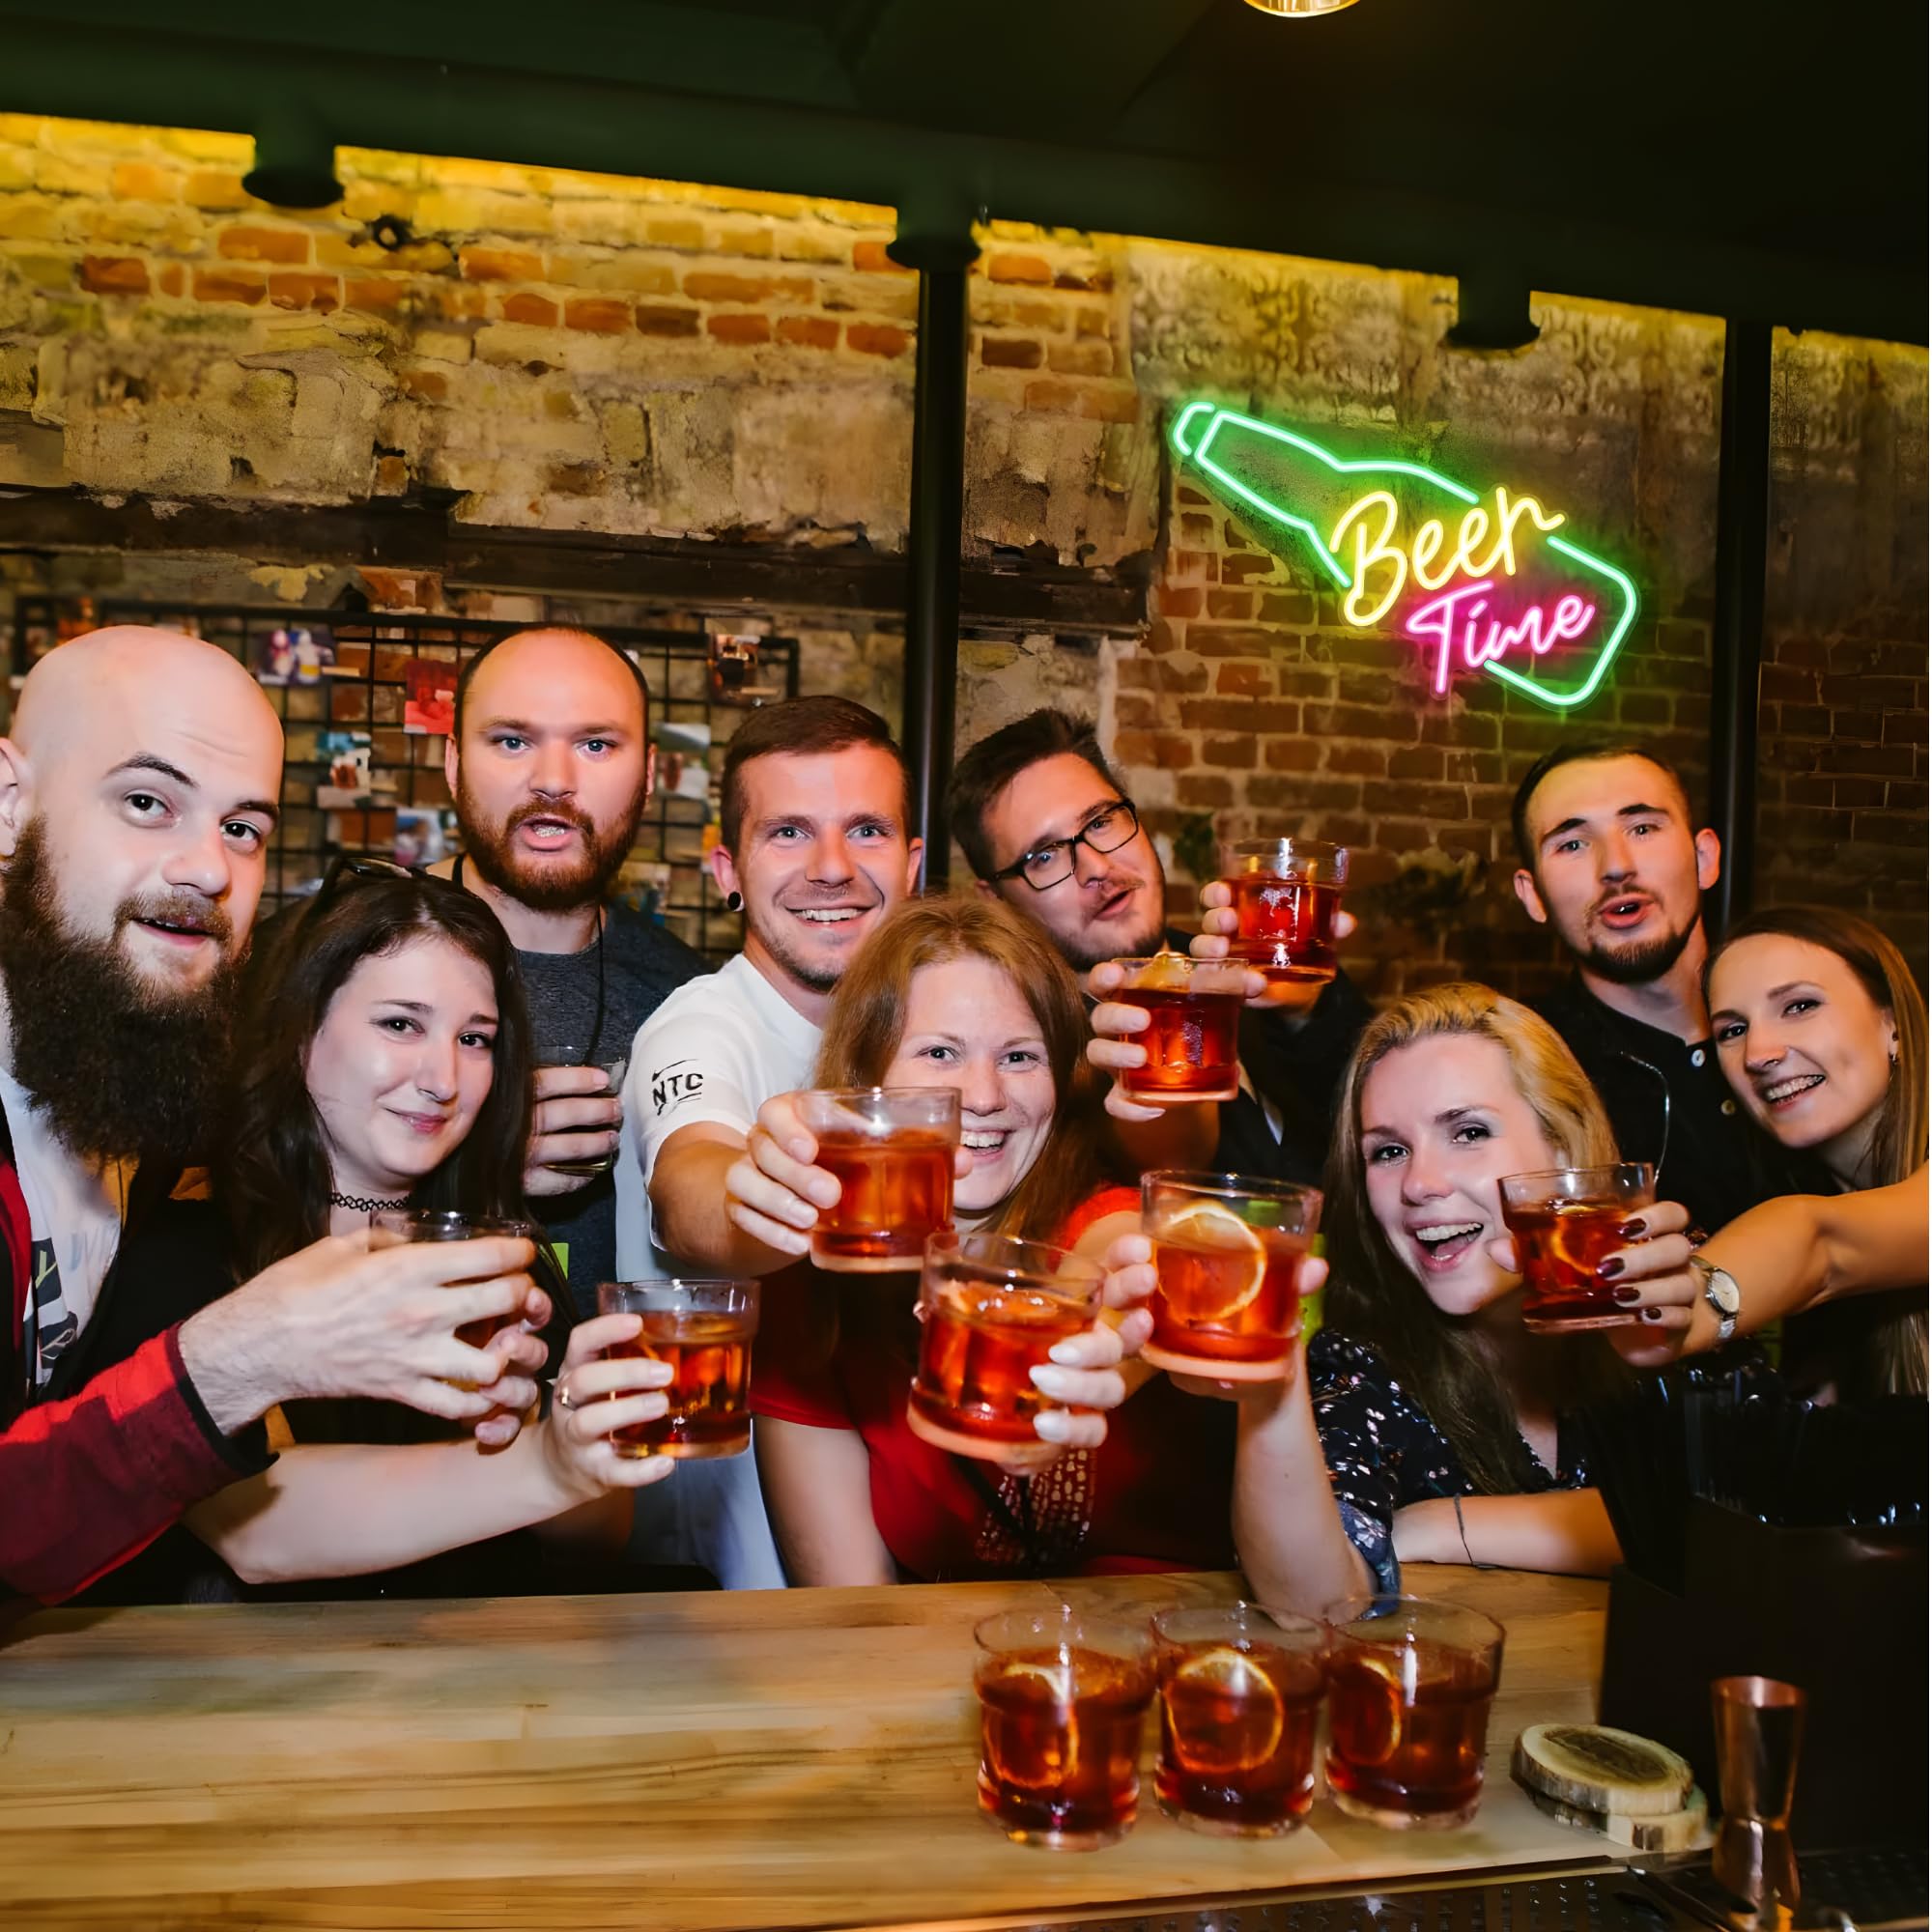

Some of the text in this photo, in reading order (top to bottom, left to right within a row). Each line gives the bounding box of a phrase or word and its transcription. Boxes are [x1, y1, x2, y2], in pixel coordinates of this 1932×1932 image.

[1329, 487, 1566, 627] Beer
[1405, 580, 1597, 694] Time
[652, 1072, 704, 1108] NTC
